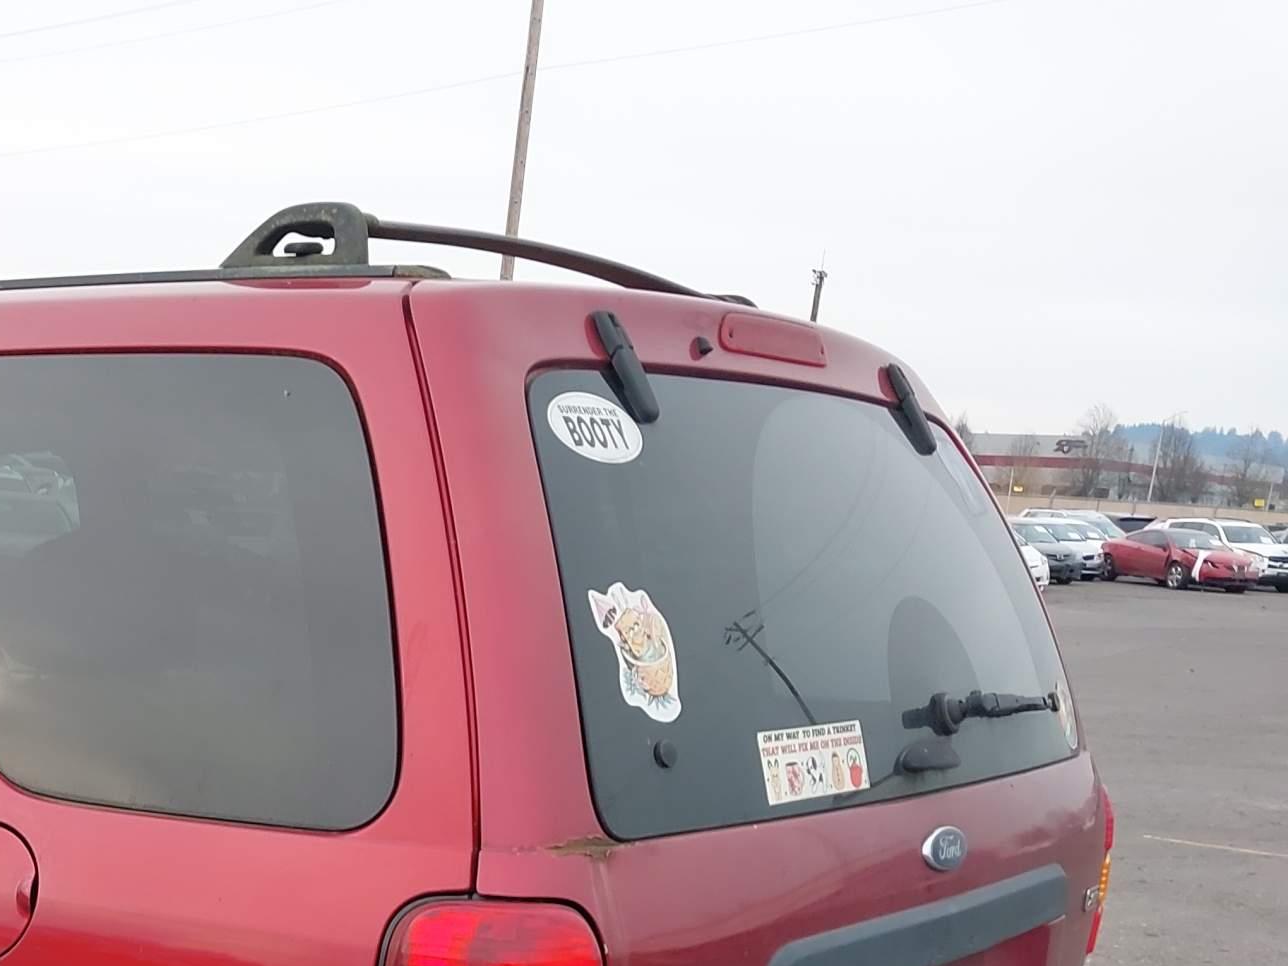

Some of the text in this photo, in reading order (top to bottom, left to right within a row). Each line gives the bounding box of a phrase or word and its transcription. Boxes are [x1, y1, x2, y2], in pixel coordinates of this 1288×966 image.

[557, 404, 618, 417] SURRENDER THE
[562, 415, 629, 450] BOOTY
[763, 734, 772, 743] ON
[774, 733, 784, 742] MY
[786, 731, 800, 740] WAY
[803, 730, 811, 738] TO
[812, 728, 826, 737] FIND
[832, 724, 856, 734] TRINKET
[762, 746, 779, 757] THAT
[781, 744, 797, 755] WILL
[799, 742, 809, 752] FIX
[810, 740, 819, 750] ME
[821, 739, 830, 749] ON
[831, 738, 842, 748] THE
[939, 835, 962, 860] Ford
